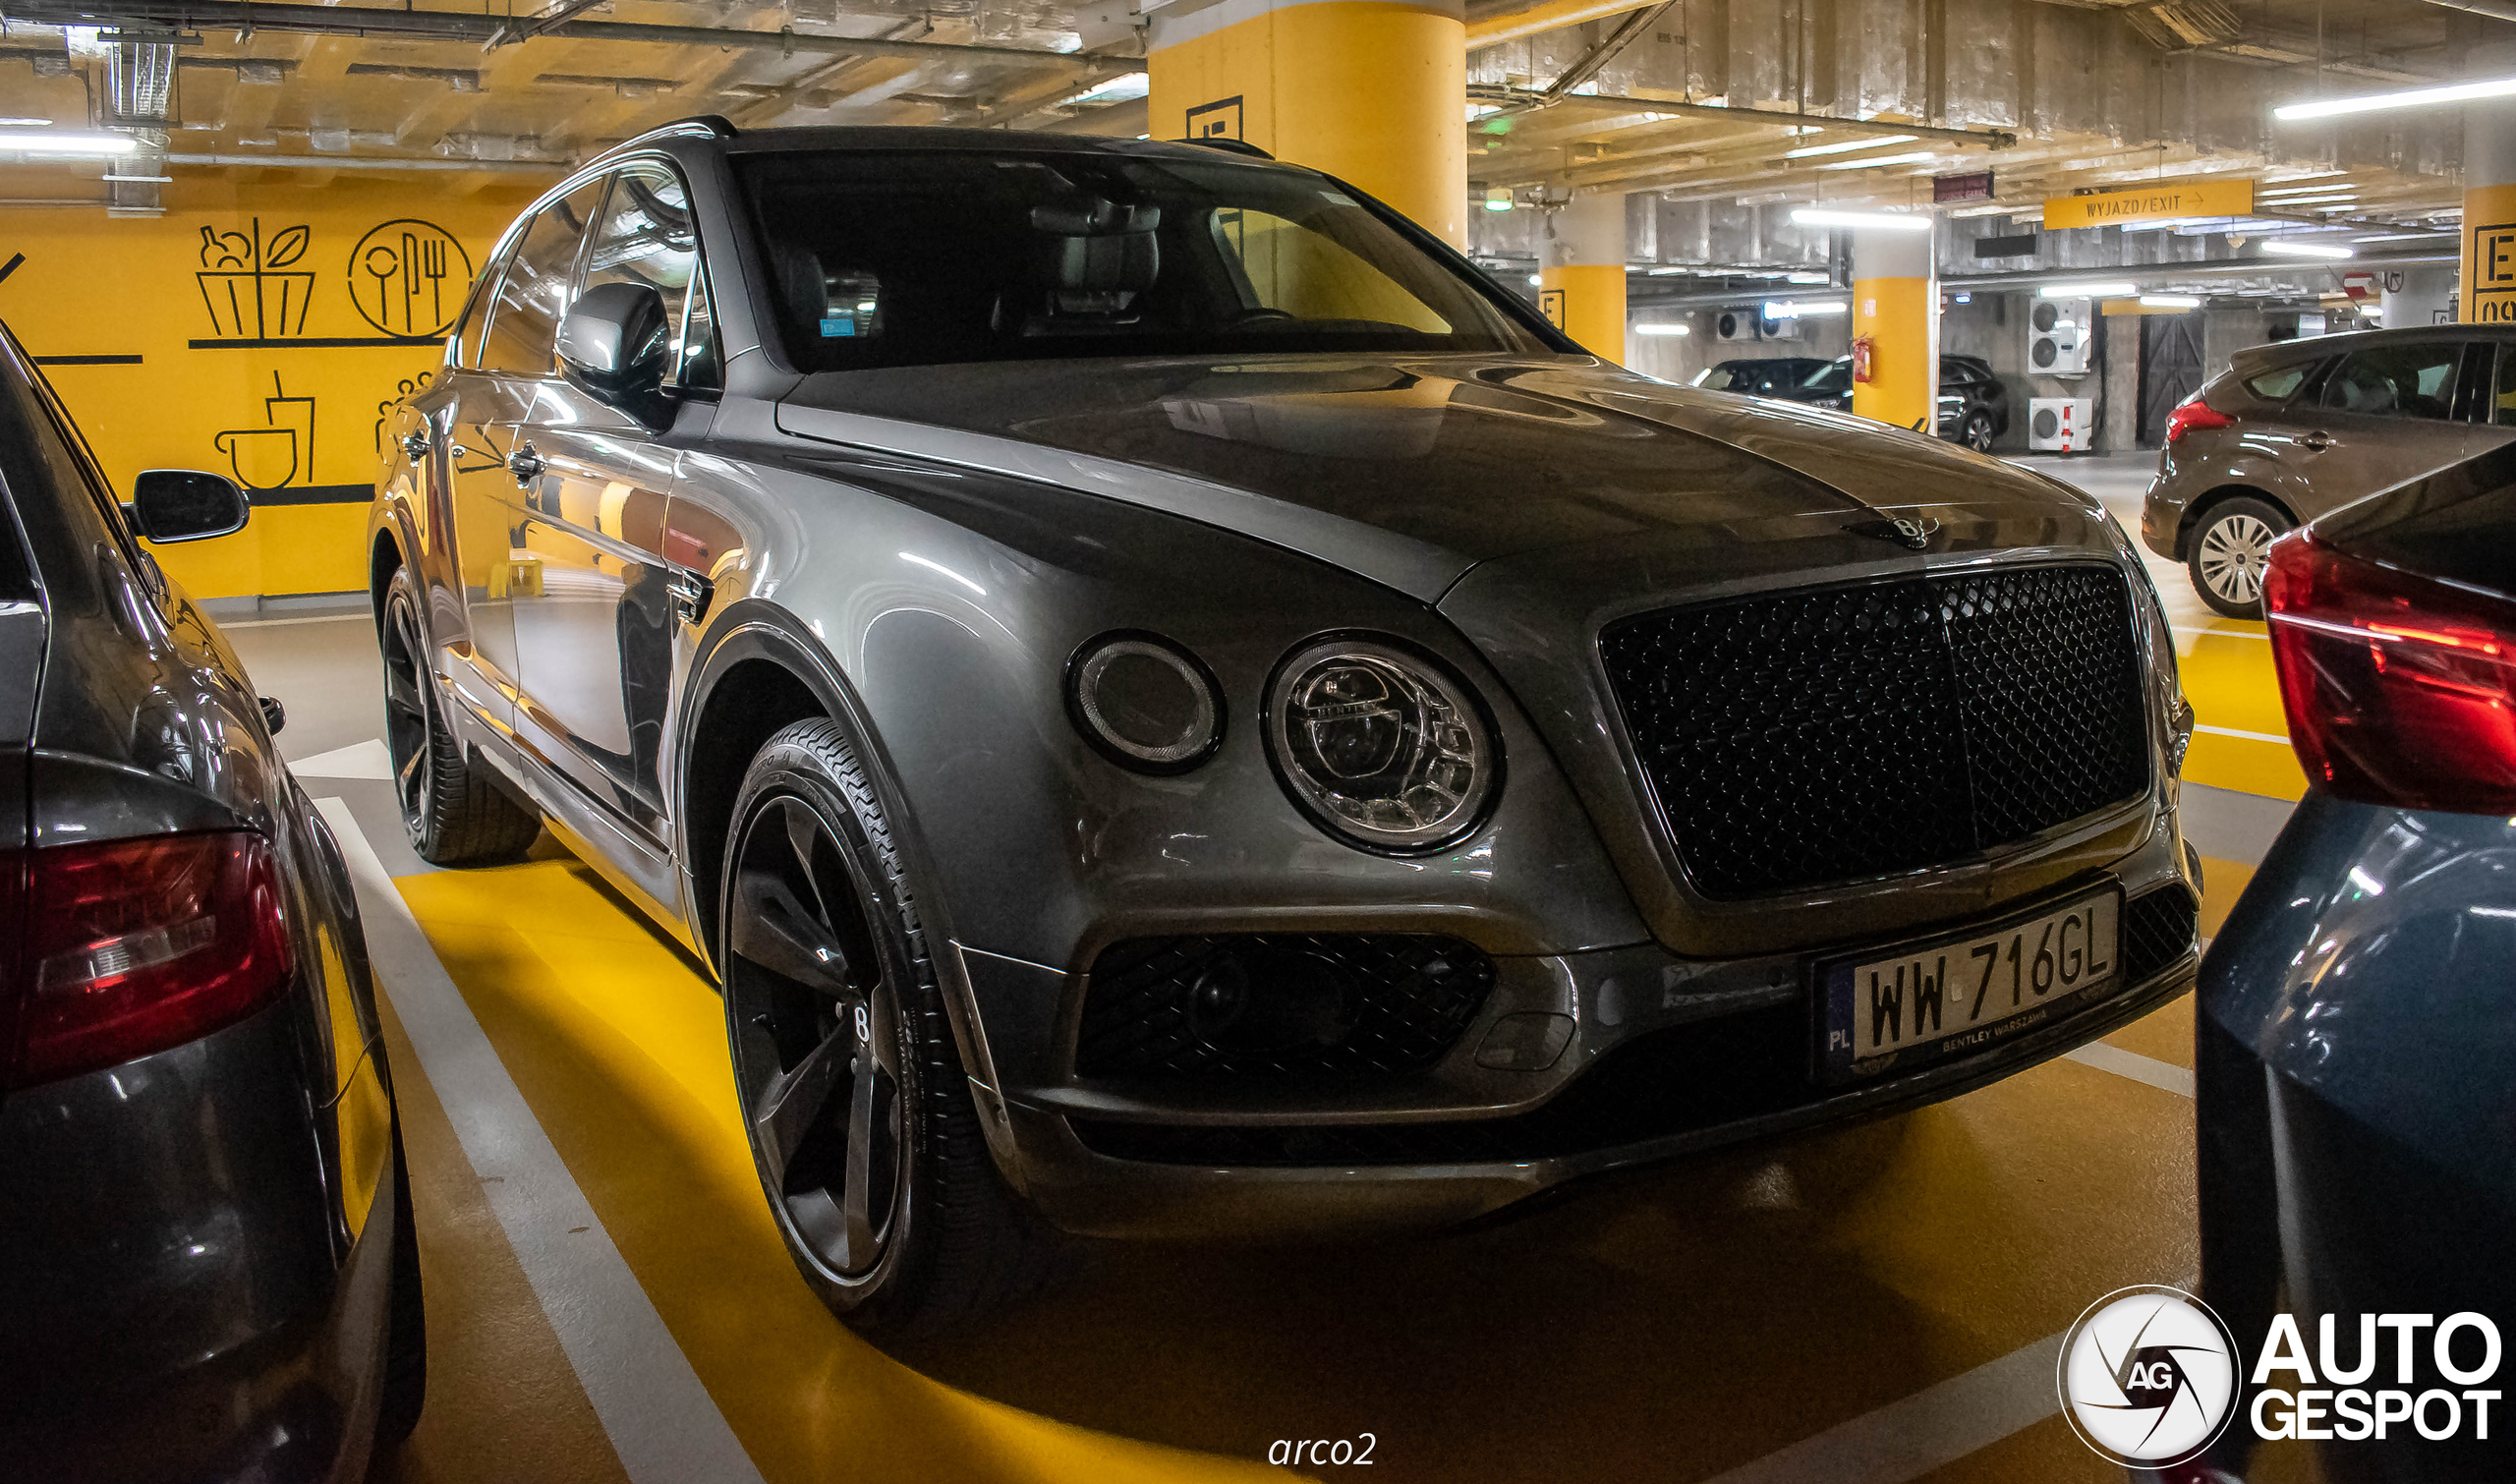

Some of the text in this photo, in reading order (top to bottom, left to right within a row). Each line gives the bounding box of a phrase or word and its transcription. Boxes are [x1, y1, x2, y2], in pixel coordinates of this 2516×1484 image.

[2087, 196, 2181, 218] WYJAZD/EXIT
[2488, 236, 2514, 281] E
[1871, 906, 2108, 1047] WW 716GL
[1829, 1028, 1851, 1052] PL
[1943, 1008, 2047, 1053] BENTLEY WARSZAWA
